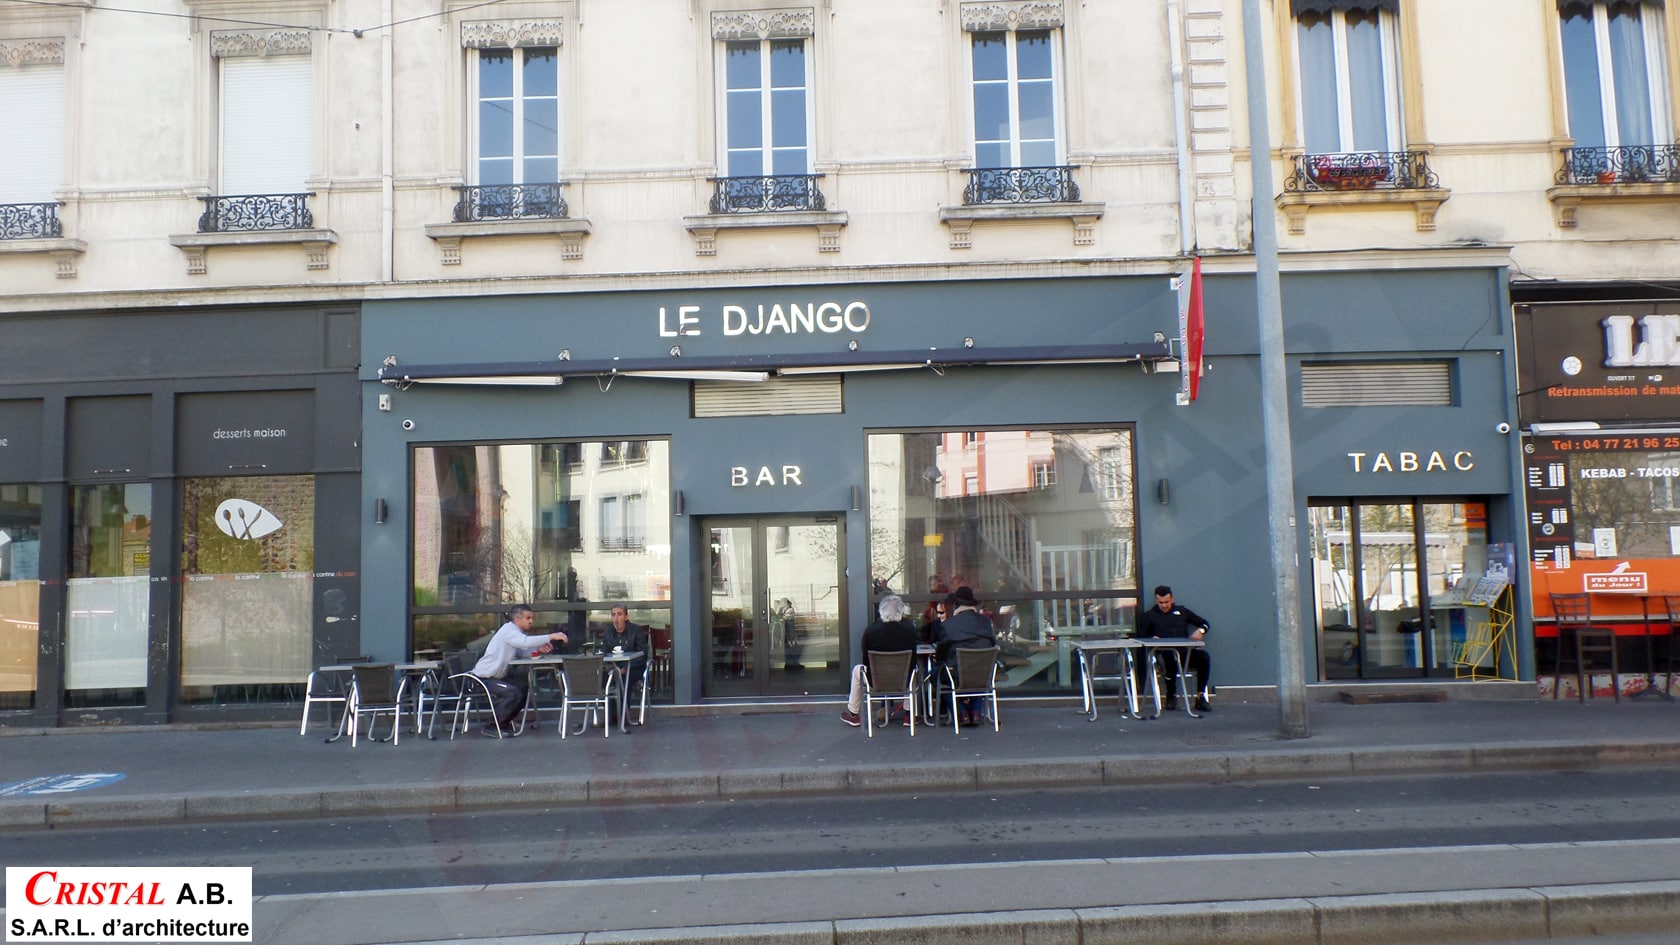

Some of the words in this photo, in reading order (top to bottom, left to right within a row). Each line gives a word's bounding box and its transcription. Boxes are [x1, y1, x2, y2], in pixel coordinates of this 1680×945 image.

[659, 305, 701, 337] LE
[723, 301, 871, 336] DJANGO
[1548, 386, 1638, 398] Retransmission
[1642, 385, 1657, 396] de
[213, 427, 251, 439] desserts
[253, 428, 286, 438] maison
[1551, 439, 1572, 451] Tel
[1583, 439, 1601, 450] 04
[1603, 439, 1619, 449] 77
[1623, 438, 1639, 449] 21
[1643, 438, 1659, 448] 96
[1664, 437, 1680, 448] 25
[1346, 450, 1476, 473] TABAC
[731, 465, 803, 487] BAR
[1581, 468, 1626, 478] KEBAB
[1637, 467, 1680, 478] TACOS
